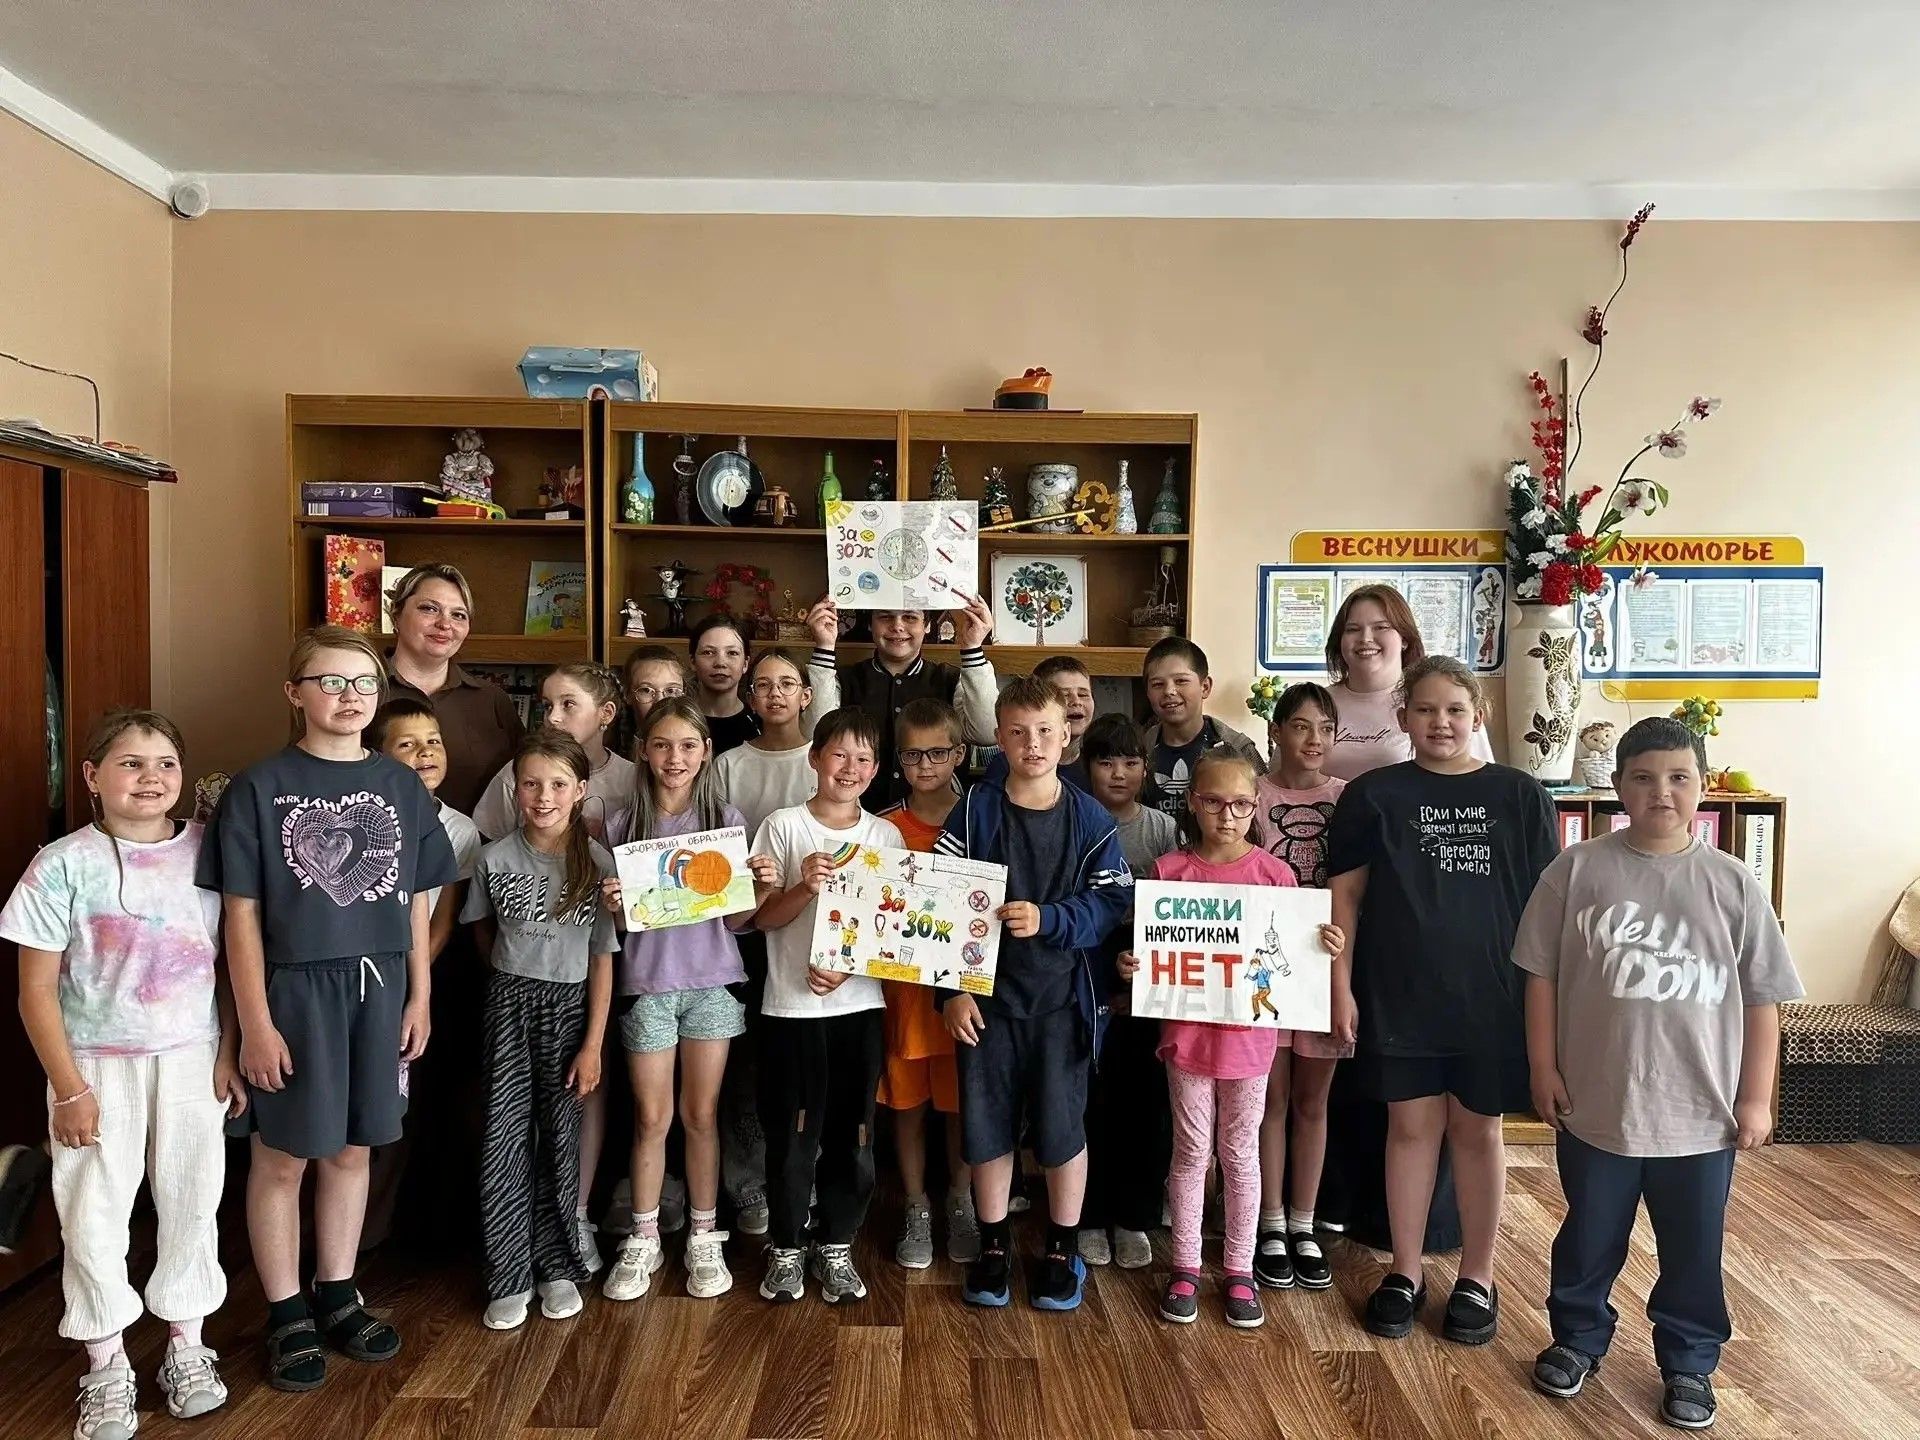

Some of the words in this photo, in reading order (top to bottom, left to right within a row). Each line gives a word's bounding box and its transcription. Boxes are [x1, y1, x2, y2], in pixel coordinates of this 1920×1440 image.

[1321, 536, 1480, 558] ВЕСНУШКИ
[1606, 541, 1776, 563] ЛУКОМОРЬЕ
[1420, 806, 1450, 822] ЕСЛИ
[624, 838, 680, 856] ЗДОРОВЫЙ
[687, 833, 719, 846] ОБРАЗ
[1154, 897, 1242, 921] СКАЖИ
[901, 910, 954, 944] ЗОЖ
[1145, 924, 1240, 944] НАРКОТИКАМ
[1151, 949, 1244, 989] НЕТ
